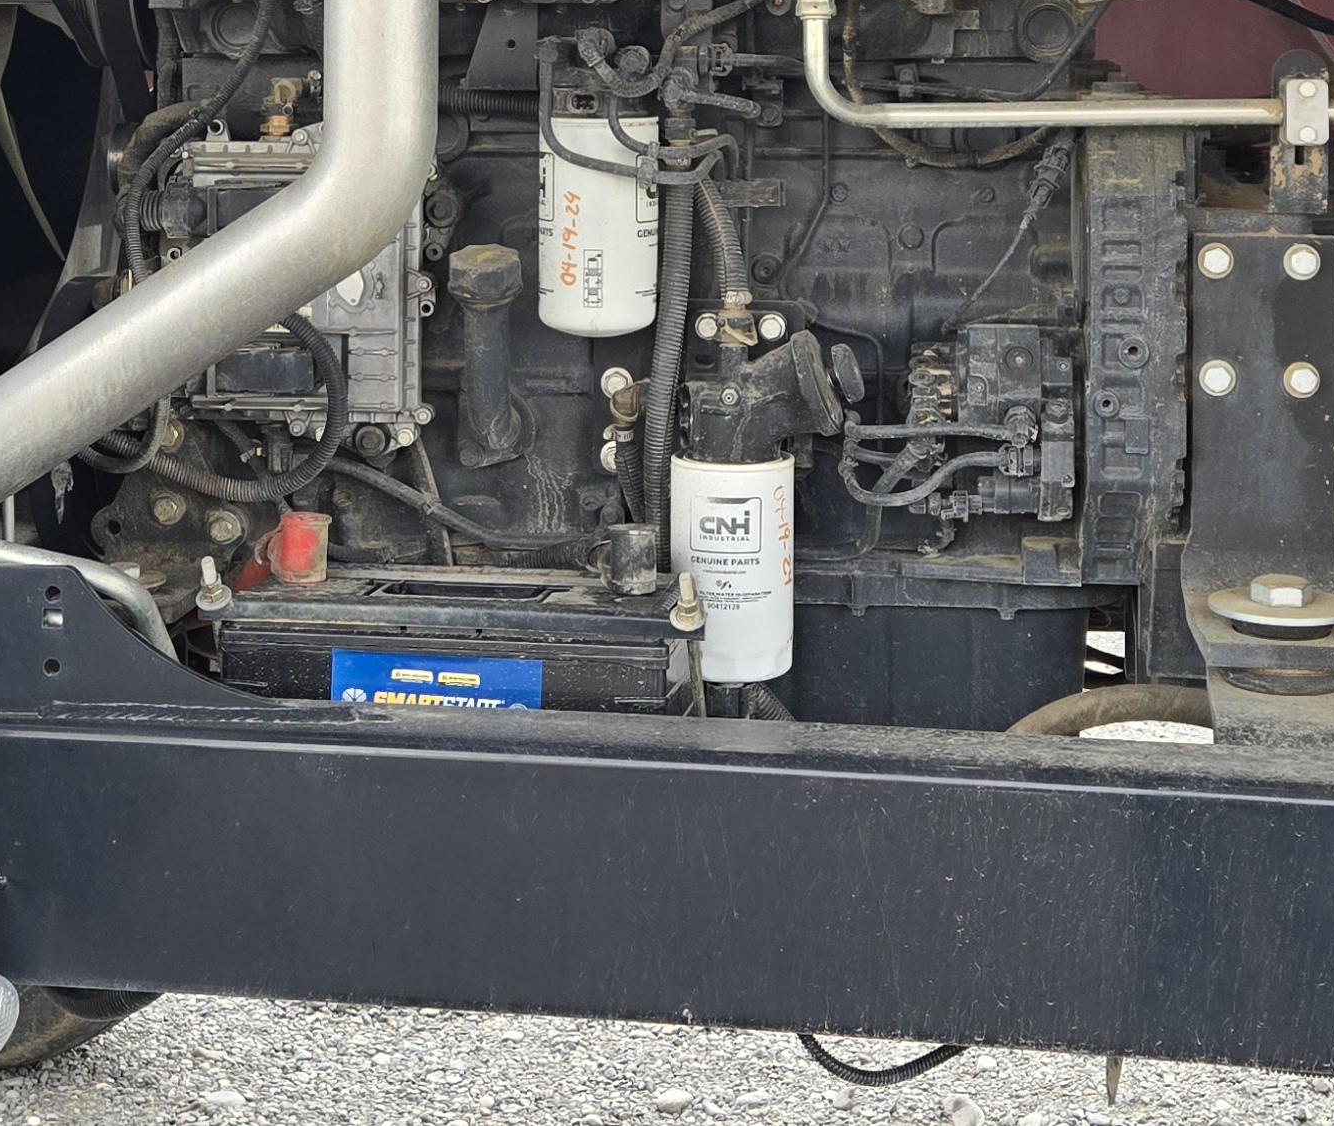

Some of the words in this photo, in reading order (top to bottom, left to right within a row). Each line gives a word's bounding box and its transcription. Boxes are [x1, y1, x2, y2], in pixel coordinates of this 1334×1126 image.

[560, 190, 581, 287] 04-19-24
[699, 534, 751, 542] INDUSTRIAL
[690, 555, 729, 566] GENUINE
[731, 558, 761, 566] PARTS
